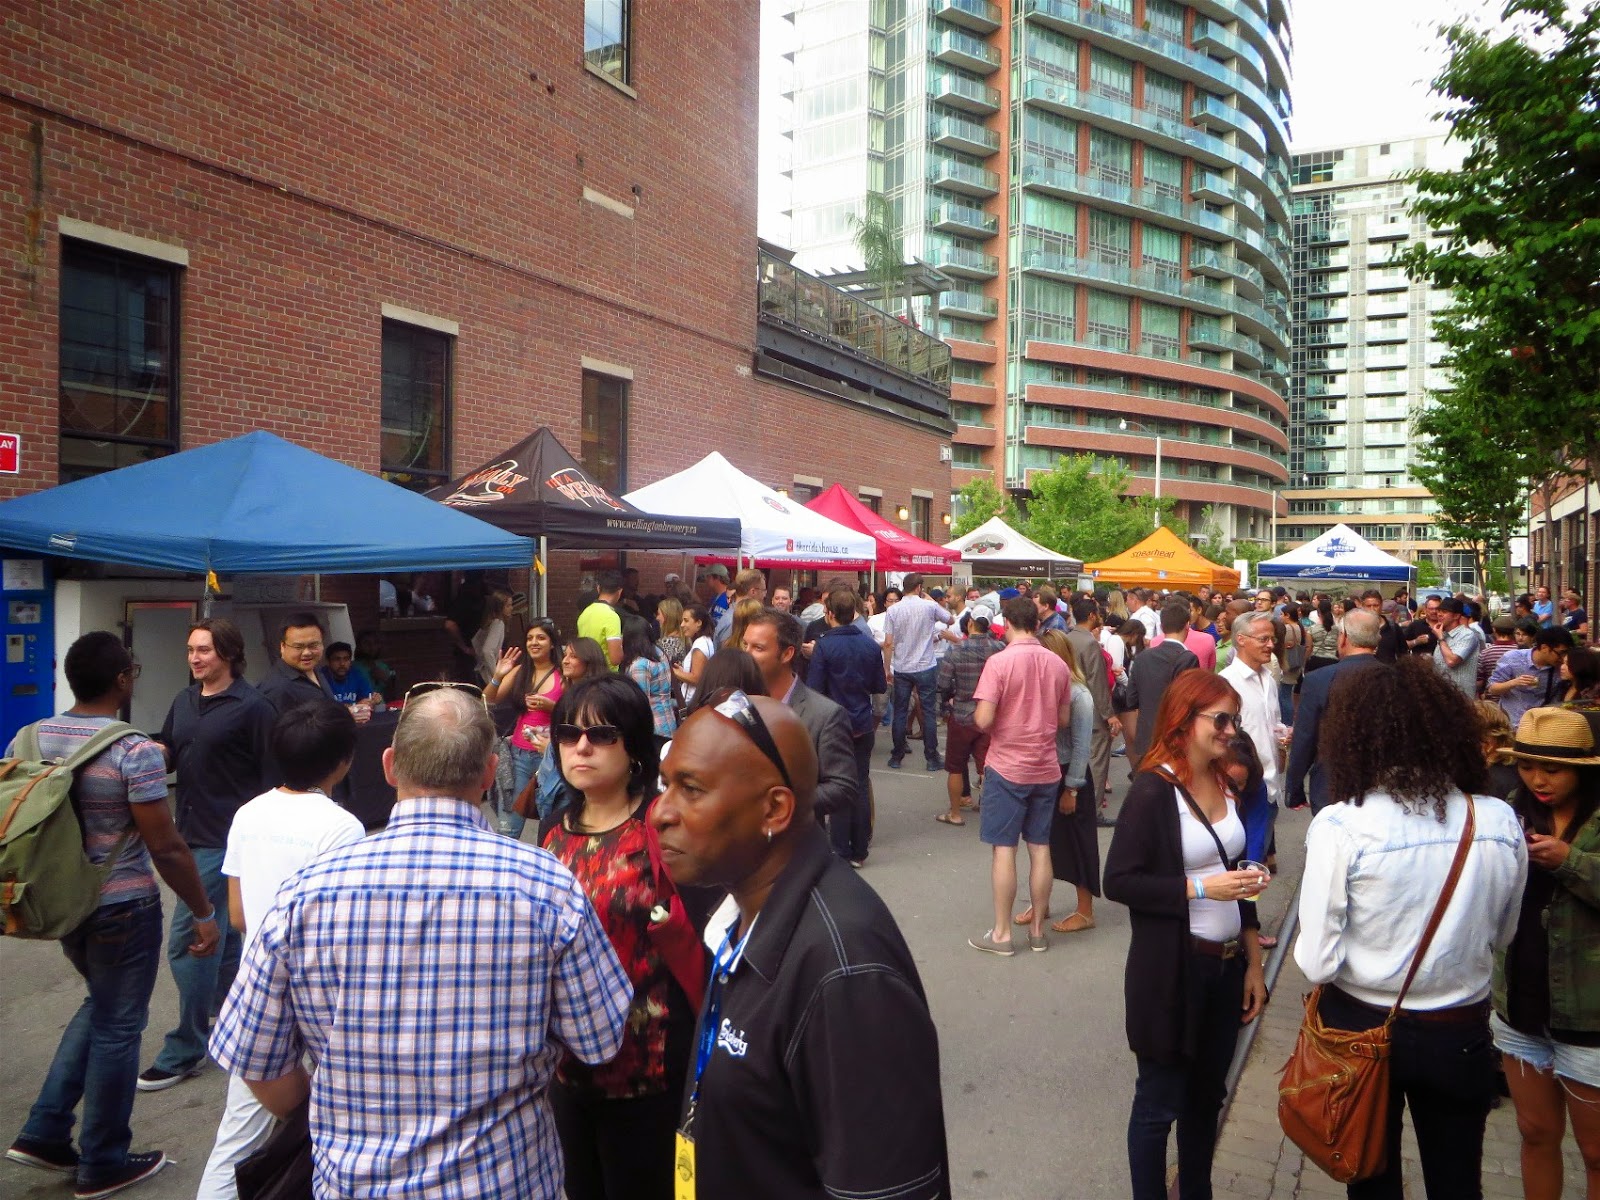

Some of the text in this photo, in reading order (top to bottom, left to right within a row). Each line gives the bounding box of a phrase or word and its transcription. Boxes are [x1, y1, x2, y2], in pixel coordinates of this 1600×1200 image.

[0, 440, 14, 449] AY
[496, 485, 516, 494] ON
[606, 519, 697, 535] www.wellingtonbrewery.ca
